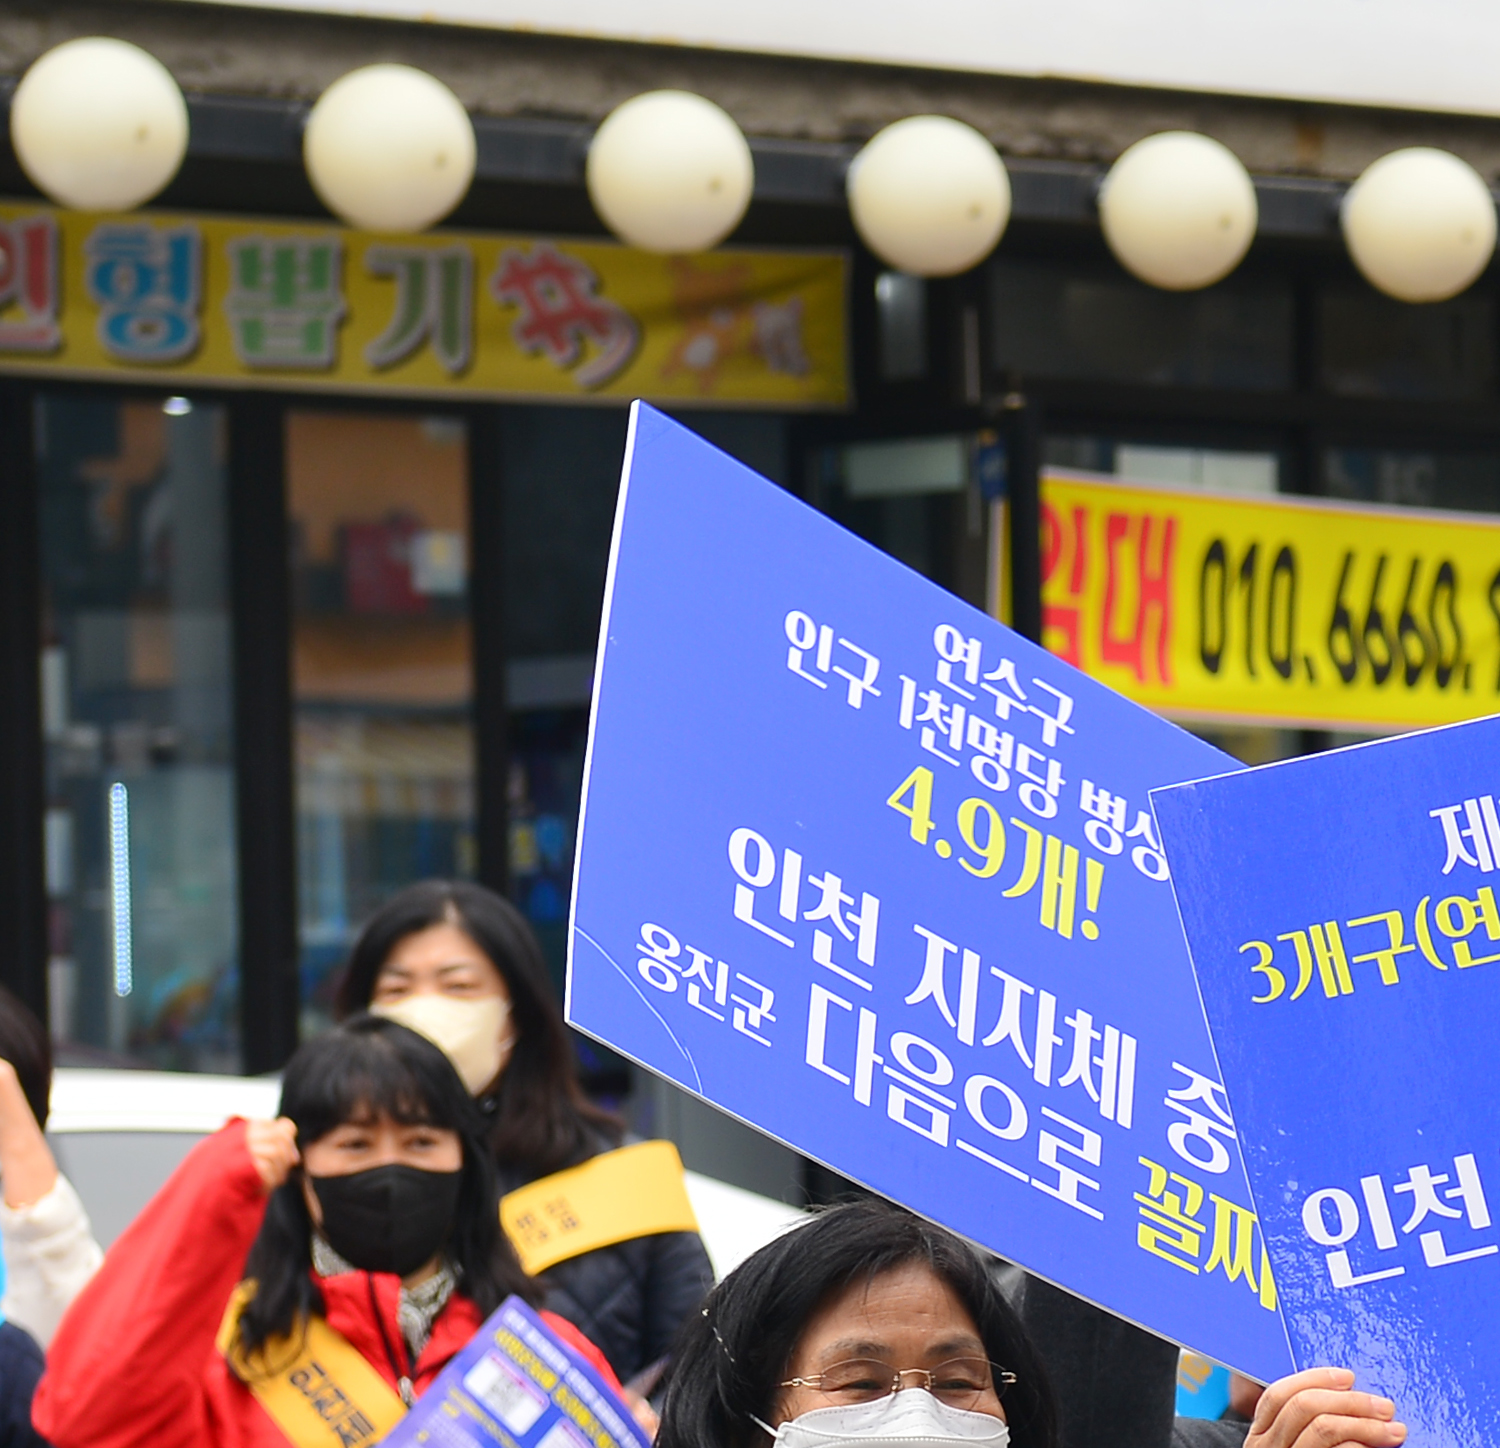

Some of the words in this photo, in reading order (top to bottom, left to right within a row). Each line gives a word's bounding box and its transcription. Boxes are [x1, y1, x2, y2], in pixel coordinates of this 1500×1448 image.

[784, 609, 882, 711] 인구
[898, 673, 1068, 821] 1천명당
[932, 622, 1076, 747] 연수구
[885, 766, 1106, 942] 4.9개!
[634, 921, 778, 1051] 옹진군
[805, 996, 1106, 1223] 다음으로
[728, 826, 881, 992] 인천
[904, 922, 1138, 1130] 지자체
[1163, 1060, 1237, 1177] 중
